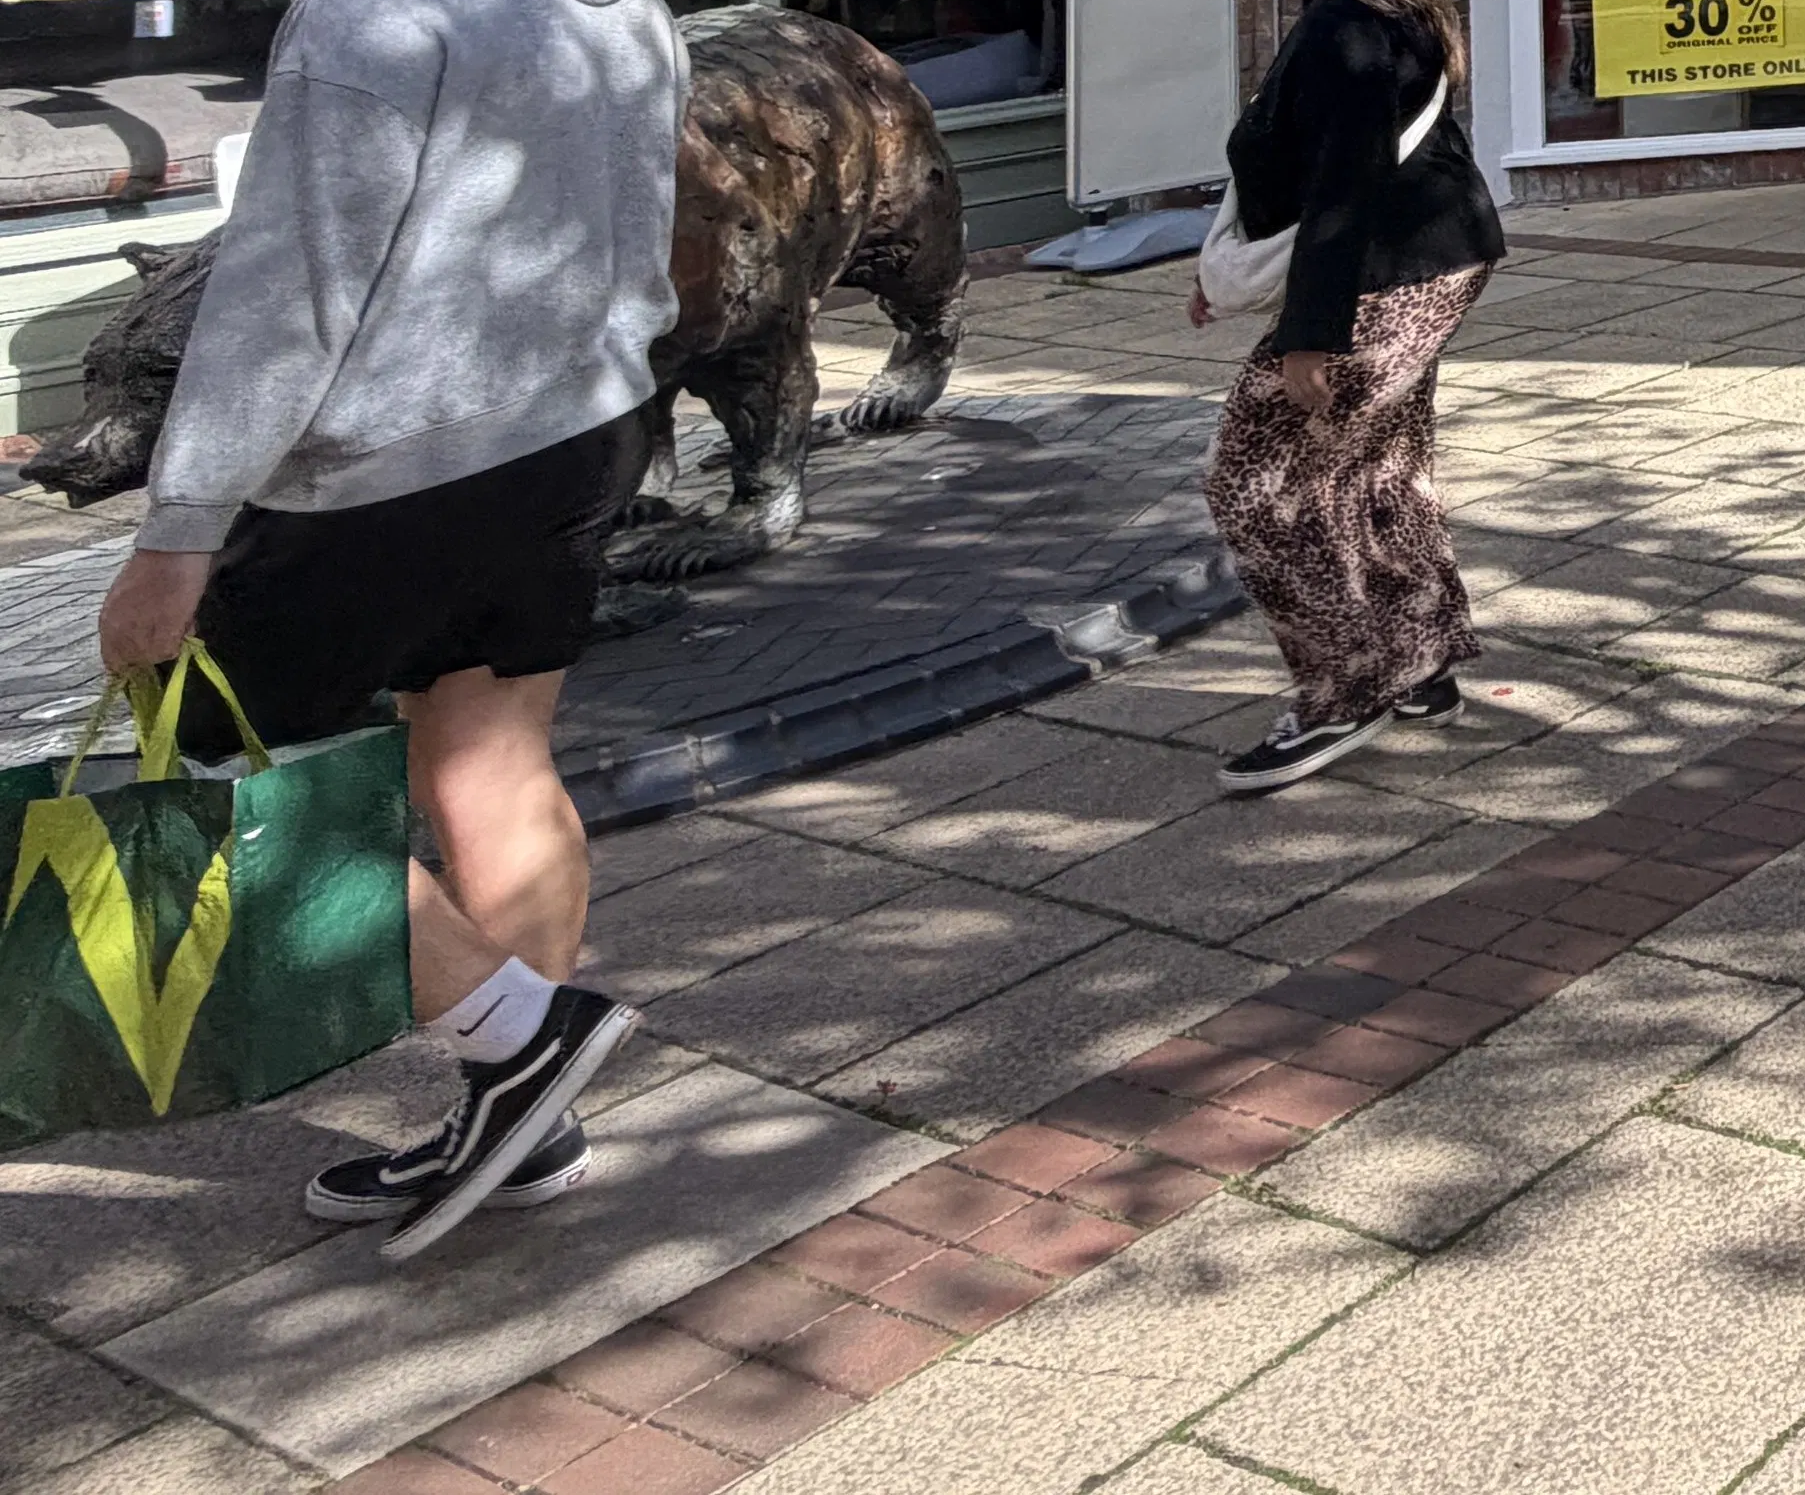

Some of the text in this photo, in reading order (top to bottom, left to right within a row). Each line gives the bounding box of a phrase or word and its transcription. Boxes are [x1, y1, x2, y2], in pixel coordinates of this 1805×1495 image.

[1738, 24, 1778, 35] OFF
[1666, 35, 1778, 49] ORIGINAL PRICE
[1626, 67, 1678, 85] THIS
[1684, 62, 1756, 81] STORE
